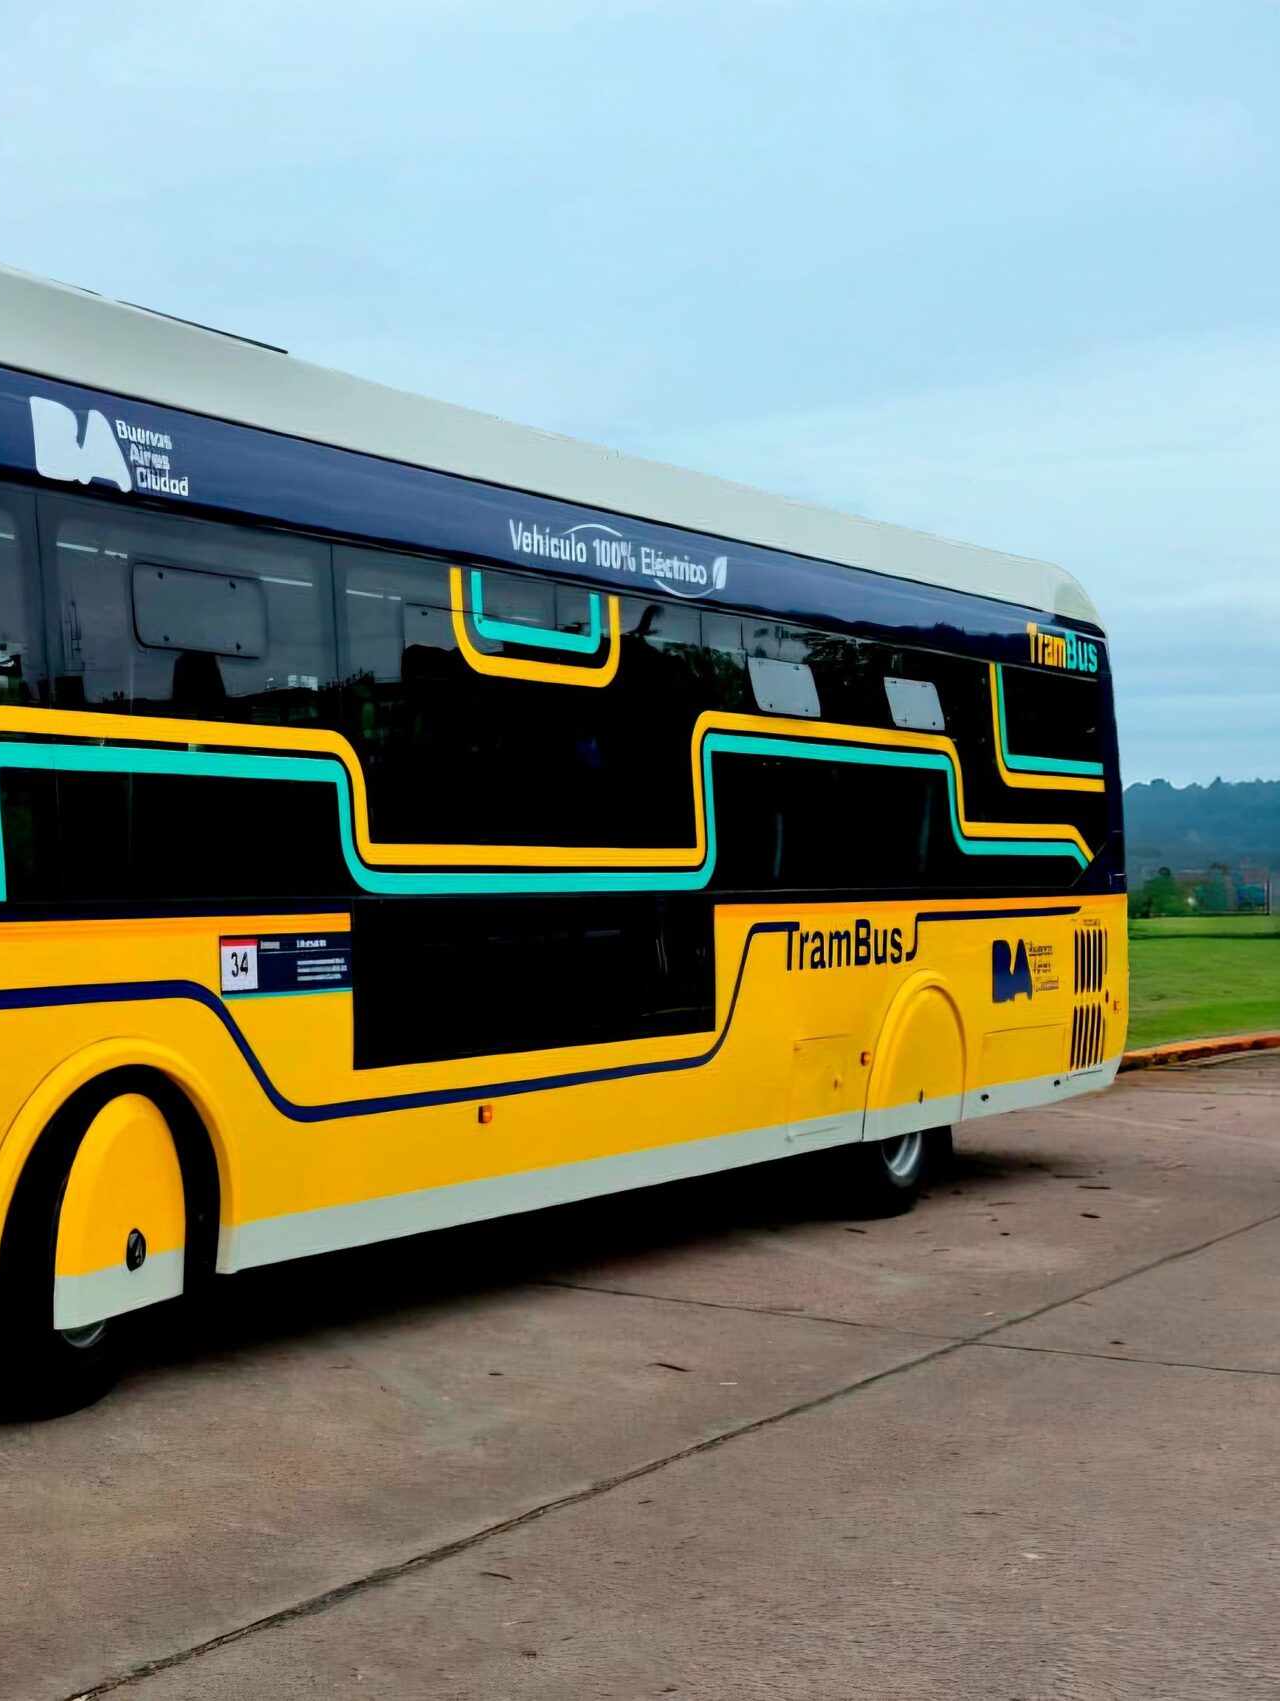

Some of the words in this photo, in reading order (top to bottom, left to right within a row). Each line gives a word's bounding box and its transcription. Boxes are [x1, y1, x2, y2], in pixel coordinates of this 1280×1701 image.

[592, 537, 636, 573] 100%
[1025, 621, 1098, 673] TramBus
[231, 951, 249, 977] 34
[784, 918, 903, 971] TramBus
